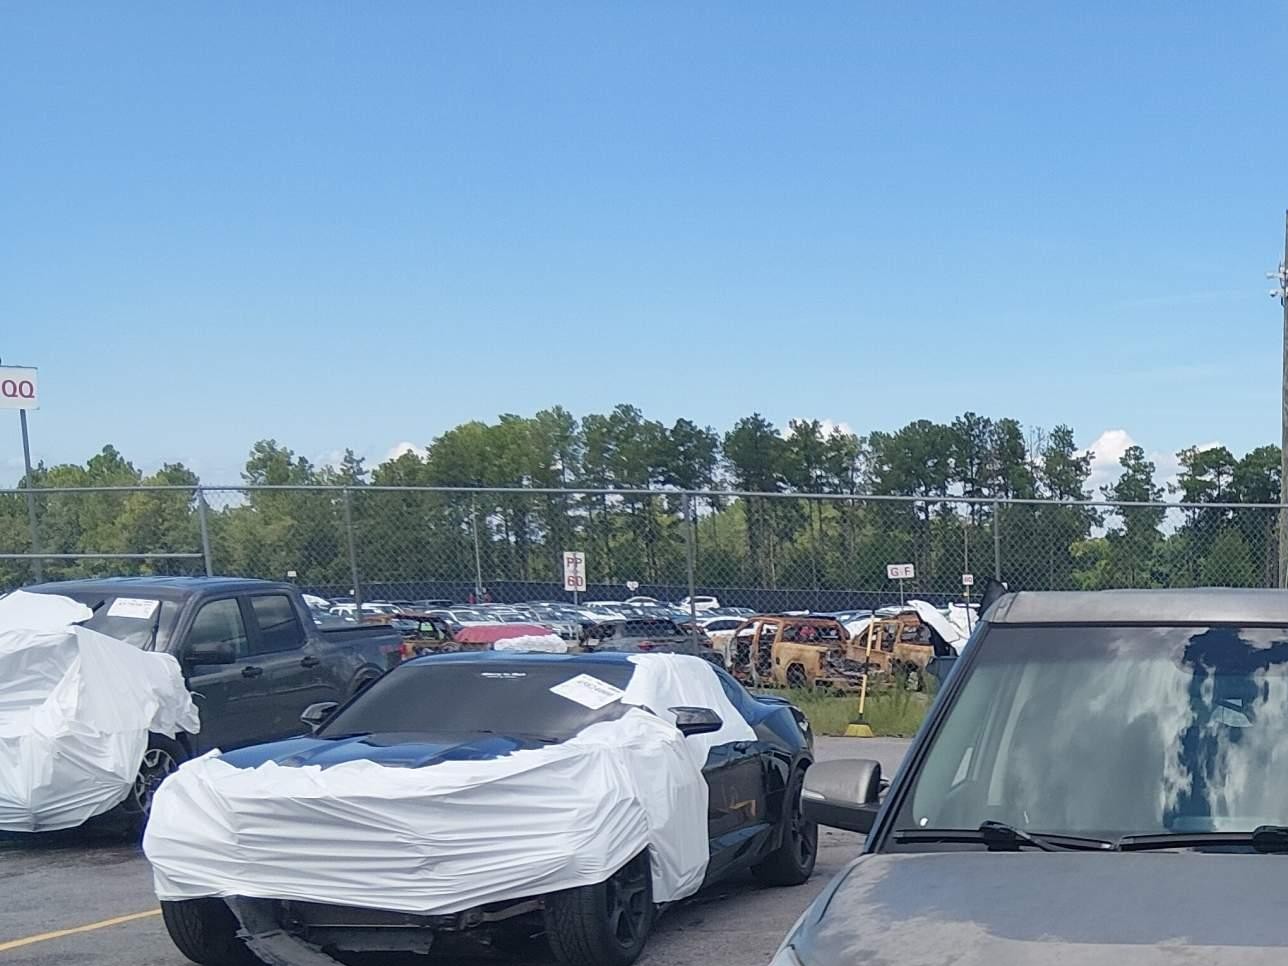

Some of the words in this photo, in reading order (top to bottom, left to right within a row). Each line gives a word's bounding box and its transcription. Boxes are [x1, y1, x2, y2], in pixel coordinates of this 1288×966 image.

[2, 380, 35, 398] QQ
[567, 557, 582, 568] PP
[567, 576, 583, 586] 60
